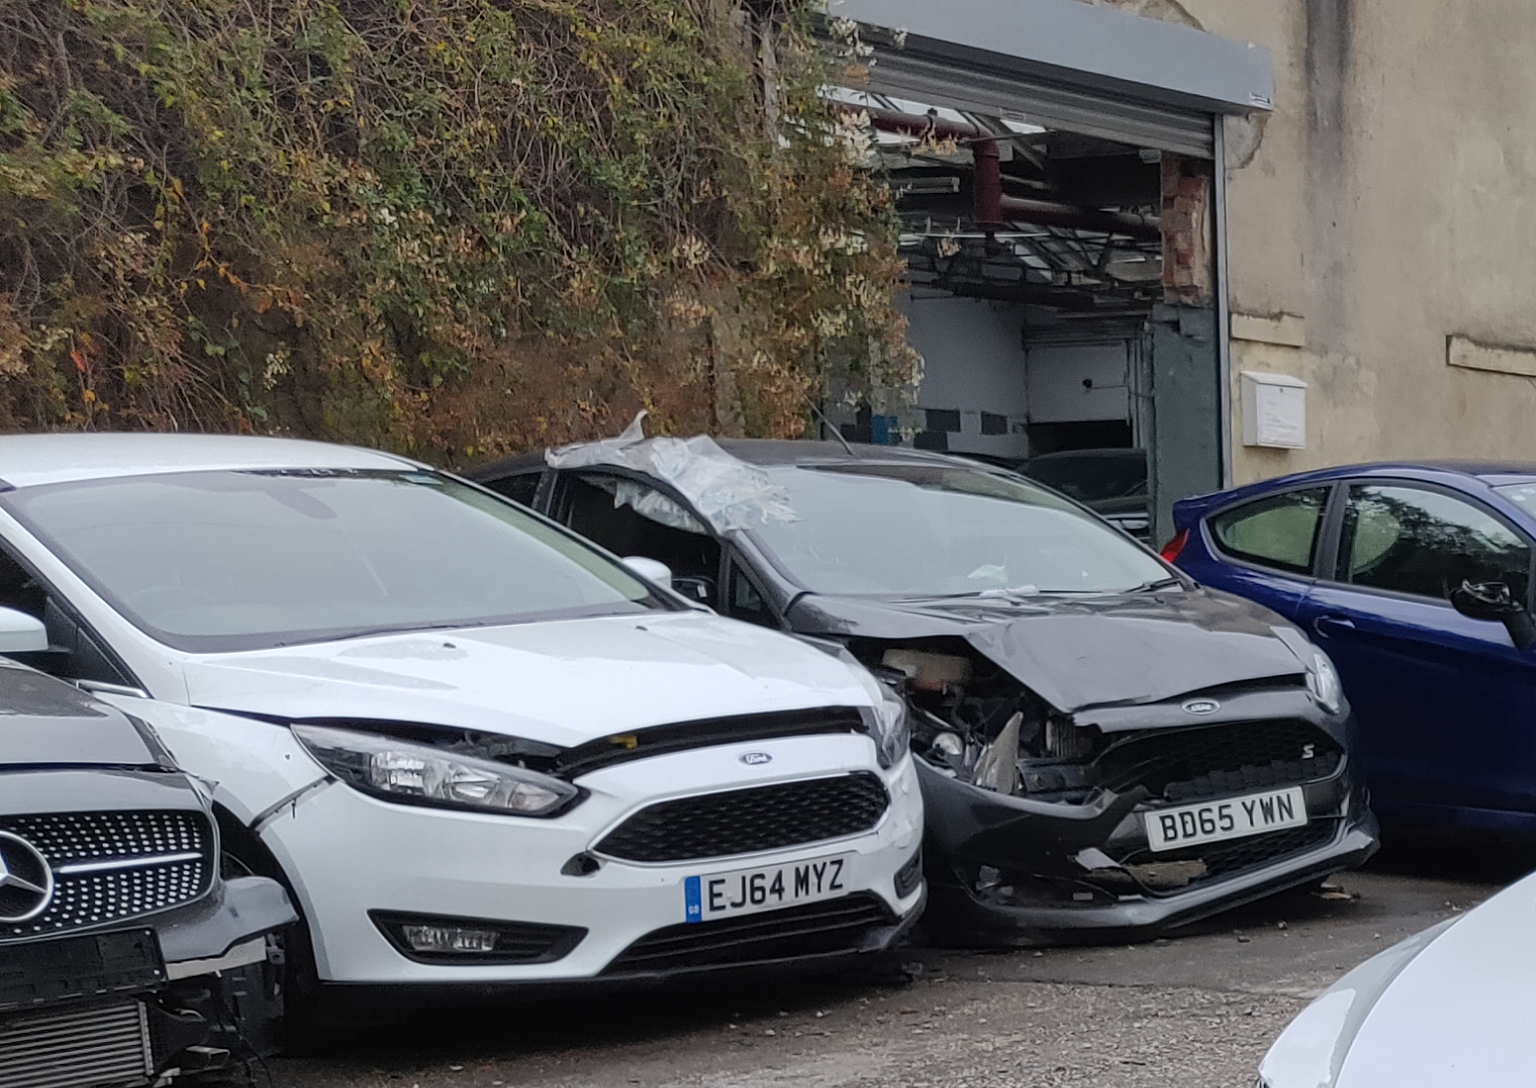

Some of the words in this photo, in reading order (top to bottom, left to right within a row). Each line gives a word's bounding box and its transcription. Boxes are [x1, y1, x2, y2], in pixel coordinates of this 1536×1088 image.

[1158, 803, 1234, 843] BD65
[1240, 792, 1295, 828] YWN
[708, 869, 785, 913] EJ64
[794, 858, 844, 899] MYZ
